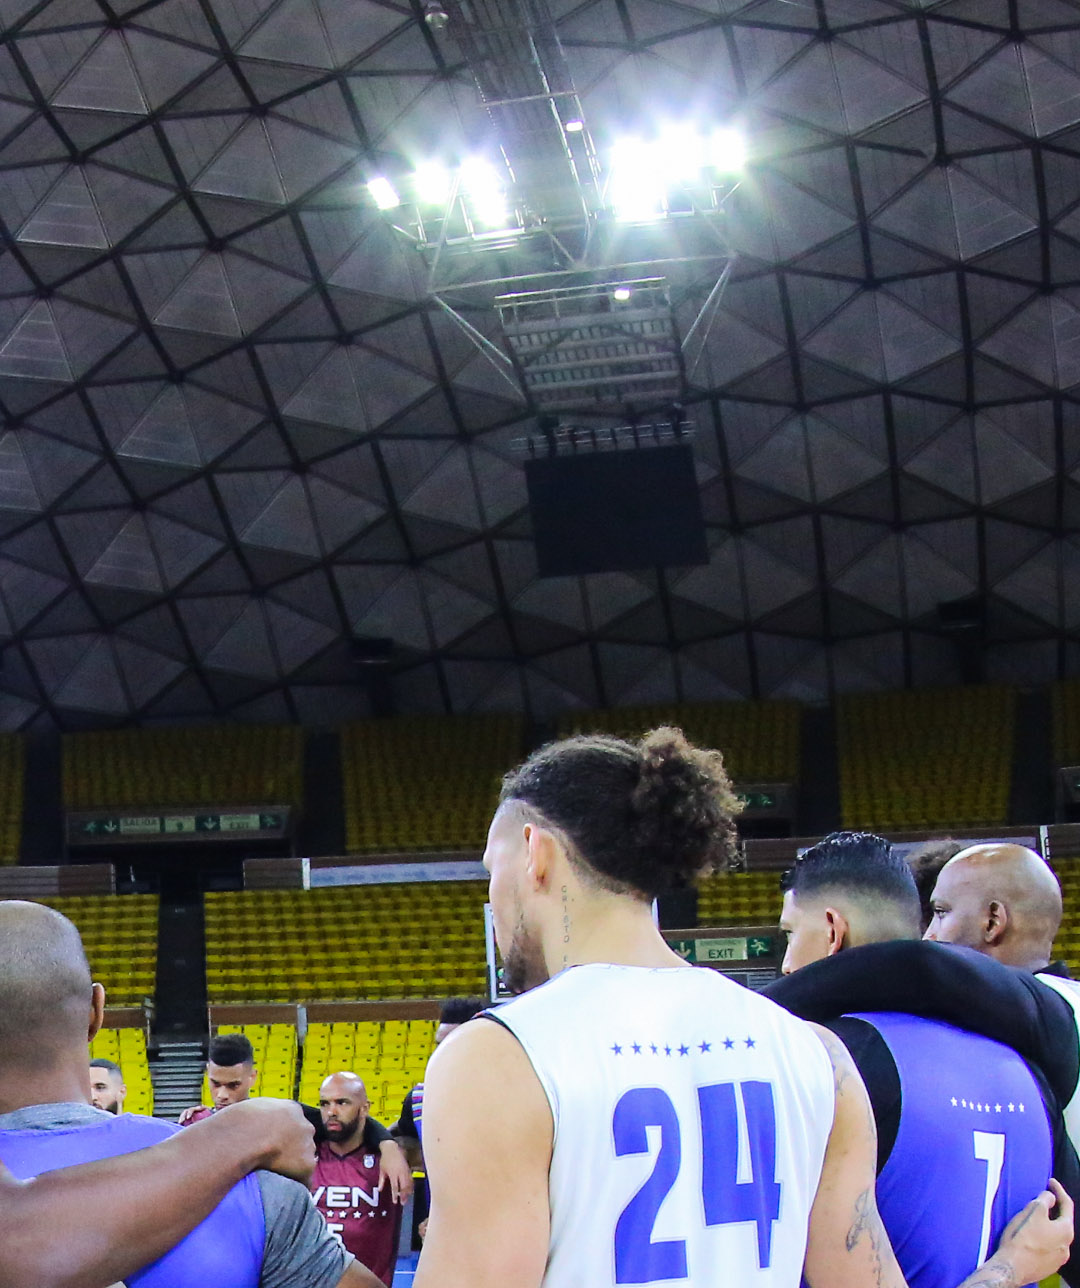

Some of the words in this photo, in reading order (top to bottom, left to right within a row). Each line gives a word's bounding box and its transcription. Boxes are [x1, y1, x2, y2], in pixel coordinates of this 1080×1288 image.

[708, 948, 735, 959] EXIT
[310, 1185, 380, 1208] VEN
[611, 1079, 783, 1285] 24
[973, 1130, 1006, 1269] 7
